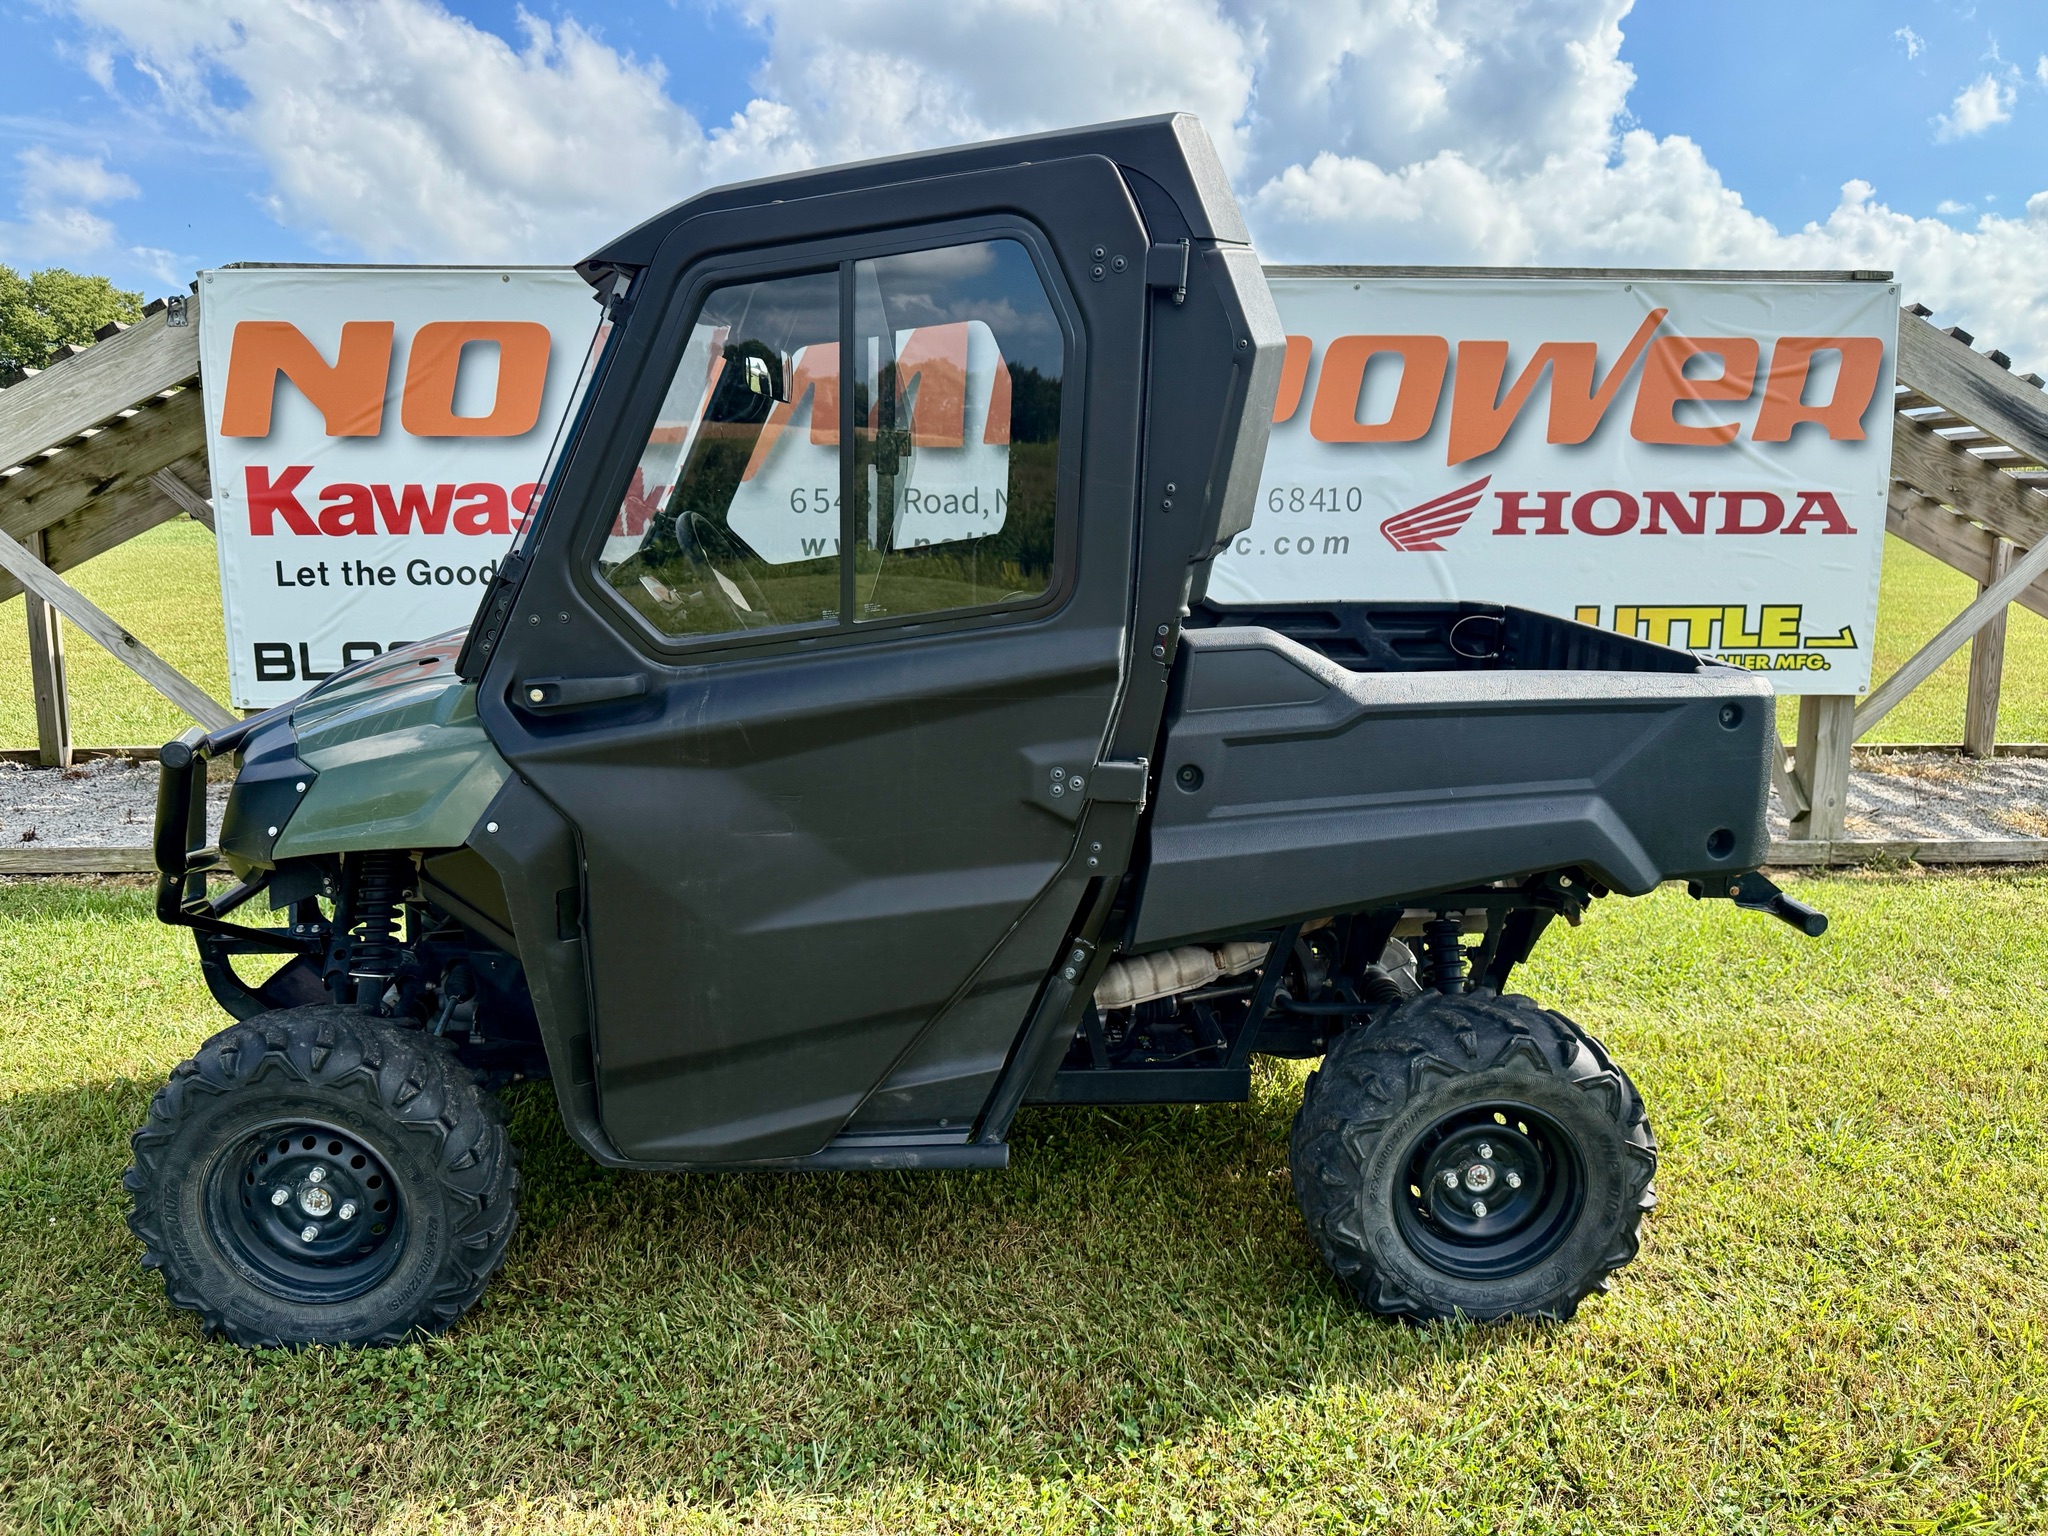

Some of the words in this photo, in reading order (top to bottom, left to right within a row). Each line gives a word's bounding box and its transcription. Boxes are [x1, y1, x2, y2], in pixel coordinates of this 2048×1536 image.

[1268, 487, 1362, 513] 68410
[1492, 490, 1857, 535] HONDA
[275, 560, 330, 587] Let
[341, 559, 397, 586] the
[406, 559, 500, 586] Good
[1774, 653, 1832, 671] MFG.
